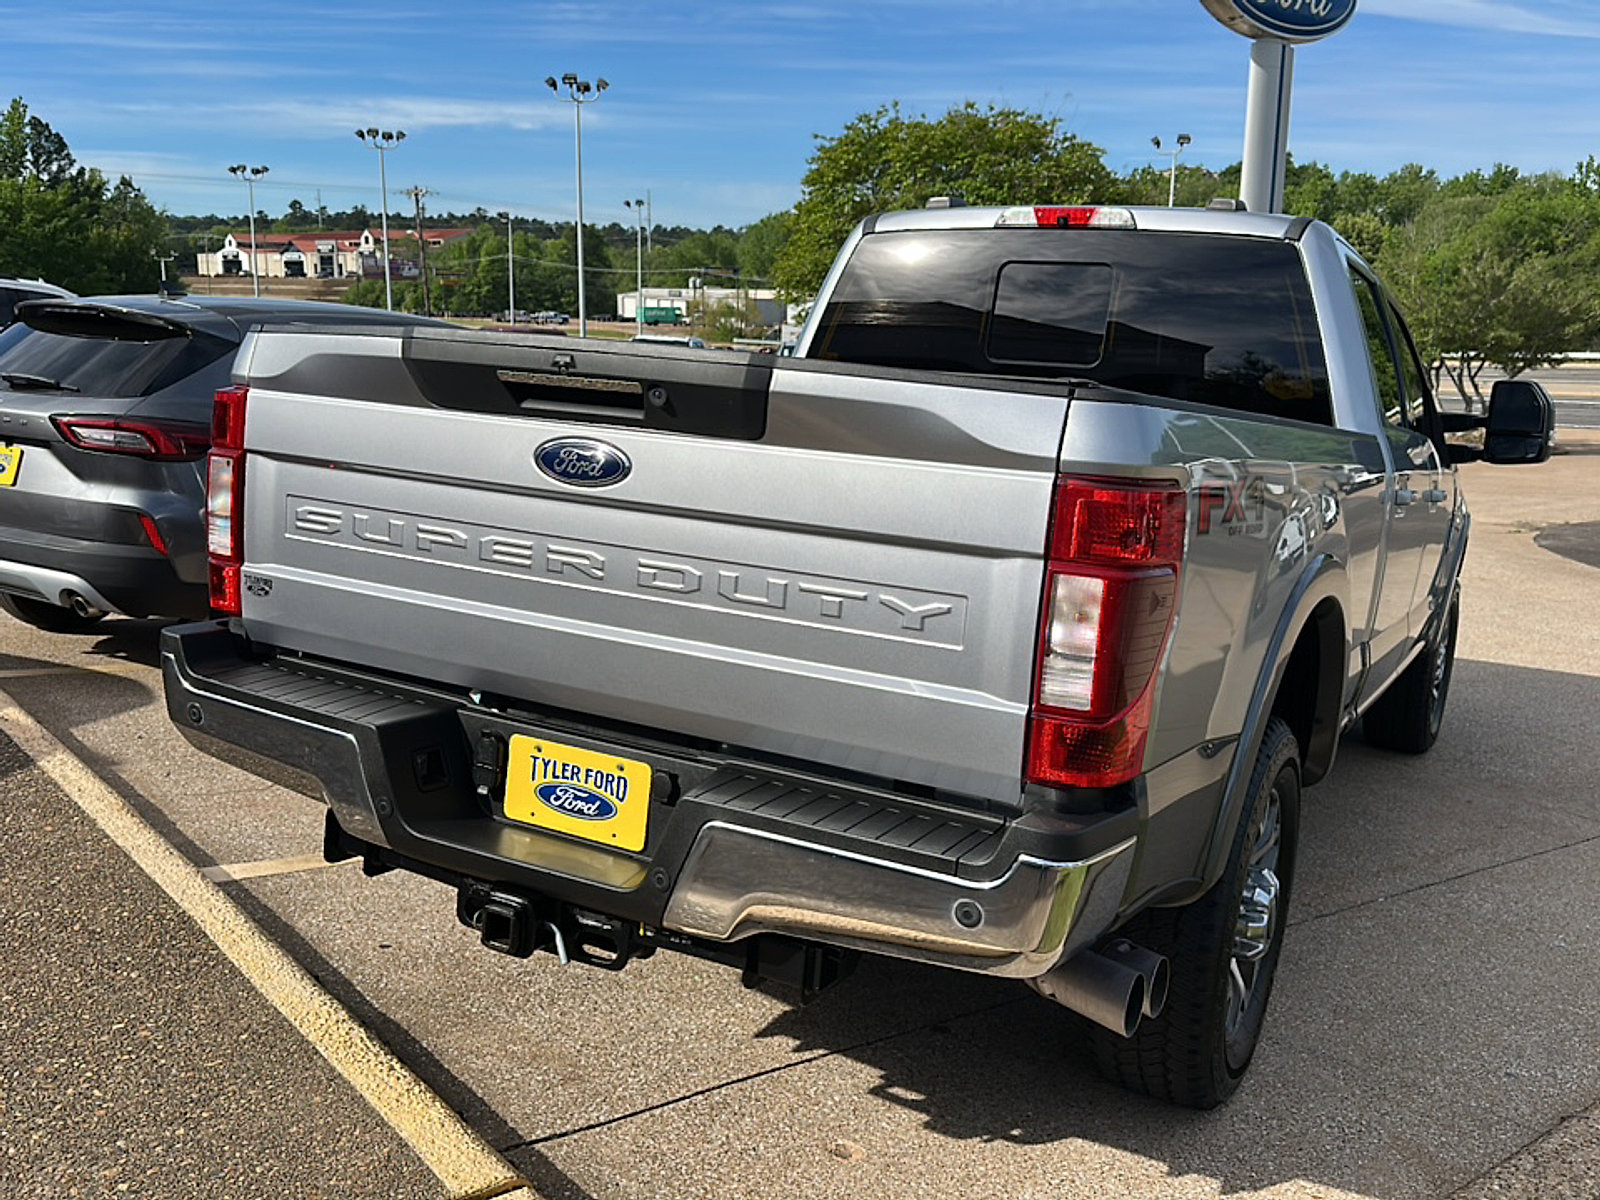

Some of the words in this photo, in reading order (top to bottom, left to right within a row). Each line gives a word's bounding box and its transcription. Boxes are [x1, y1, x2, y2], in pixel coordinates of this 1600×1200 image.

[553, 447, 605, 477] Ford
[1196, 475, 1264, 535] FX4
[295, 505, 606, 582] SUPER
[636, 557, 953, 632] DUTY
[529, 754, 582, 783] TYLER
[583, 768, 628, 803] FORD
[550, 786, 601, 816] Ford
